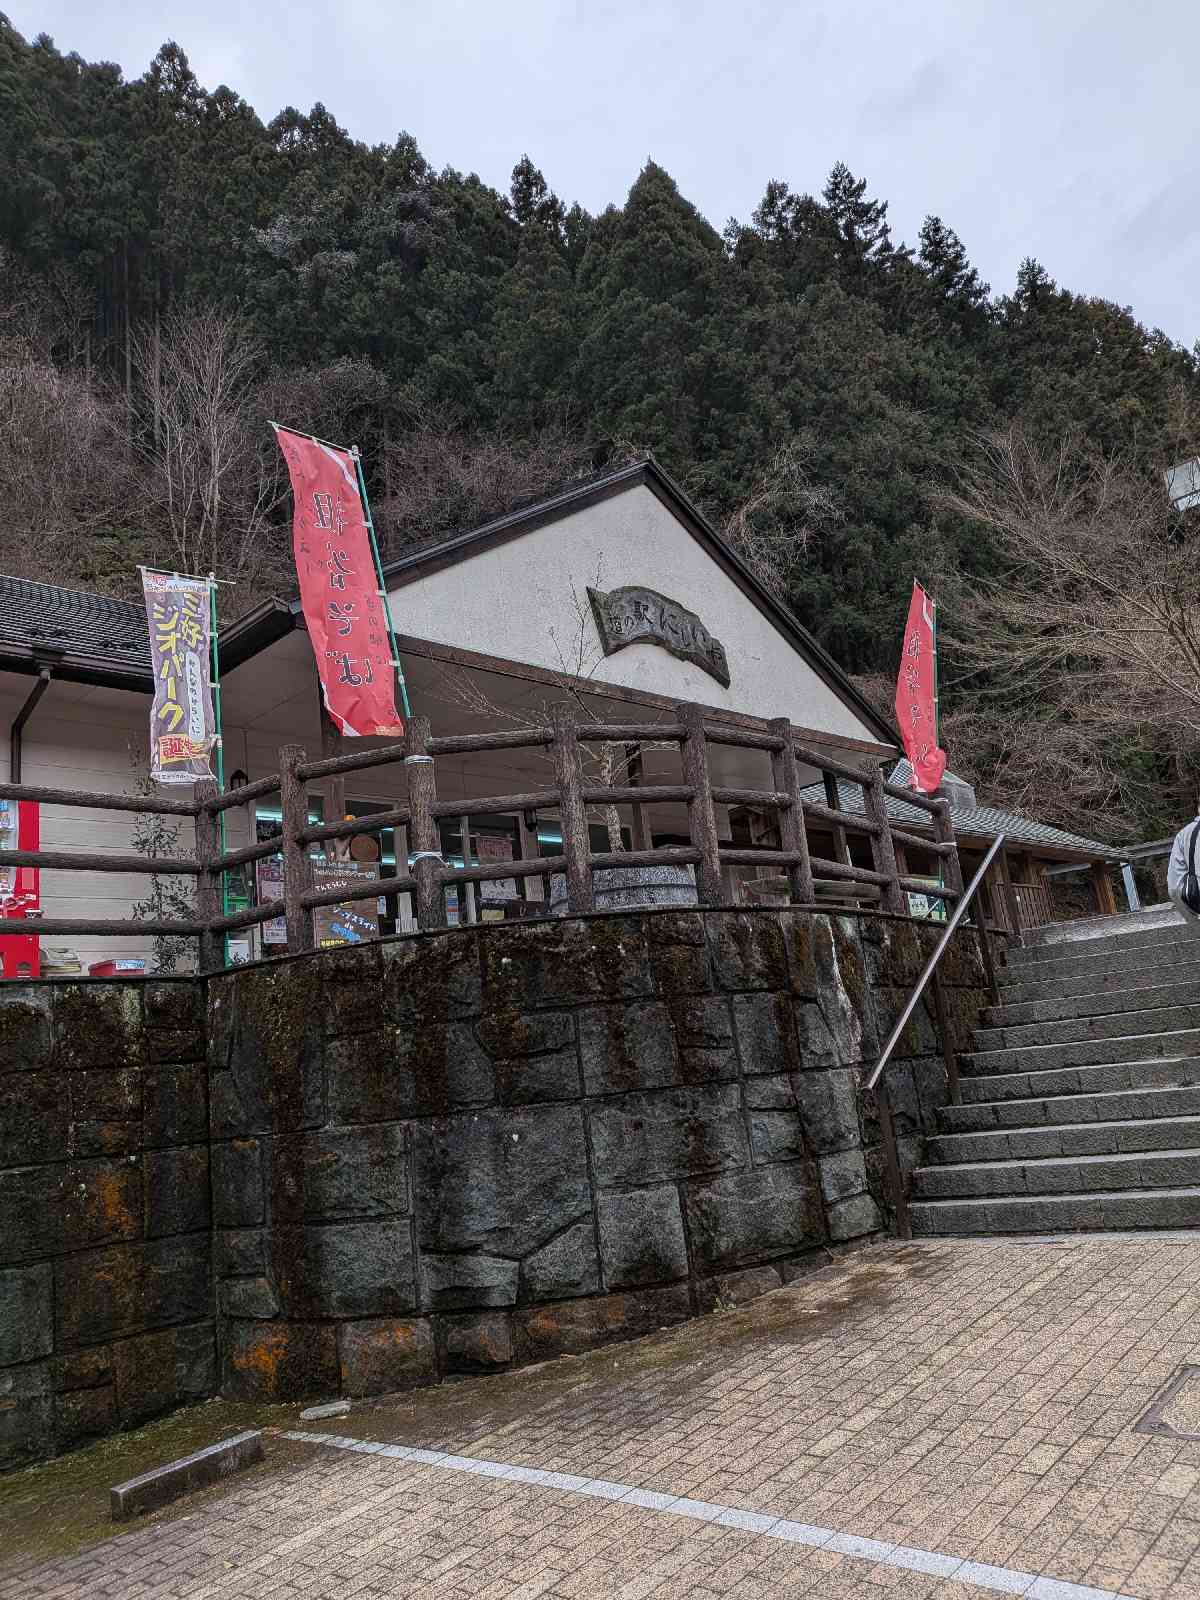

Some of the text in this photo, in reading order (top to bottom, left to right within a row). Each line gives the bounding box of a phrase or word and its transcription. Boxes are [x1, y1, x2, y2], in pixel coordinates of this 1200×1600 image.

[153, 602, 184, 731] ジオパーク
